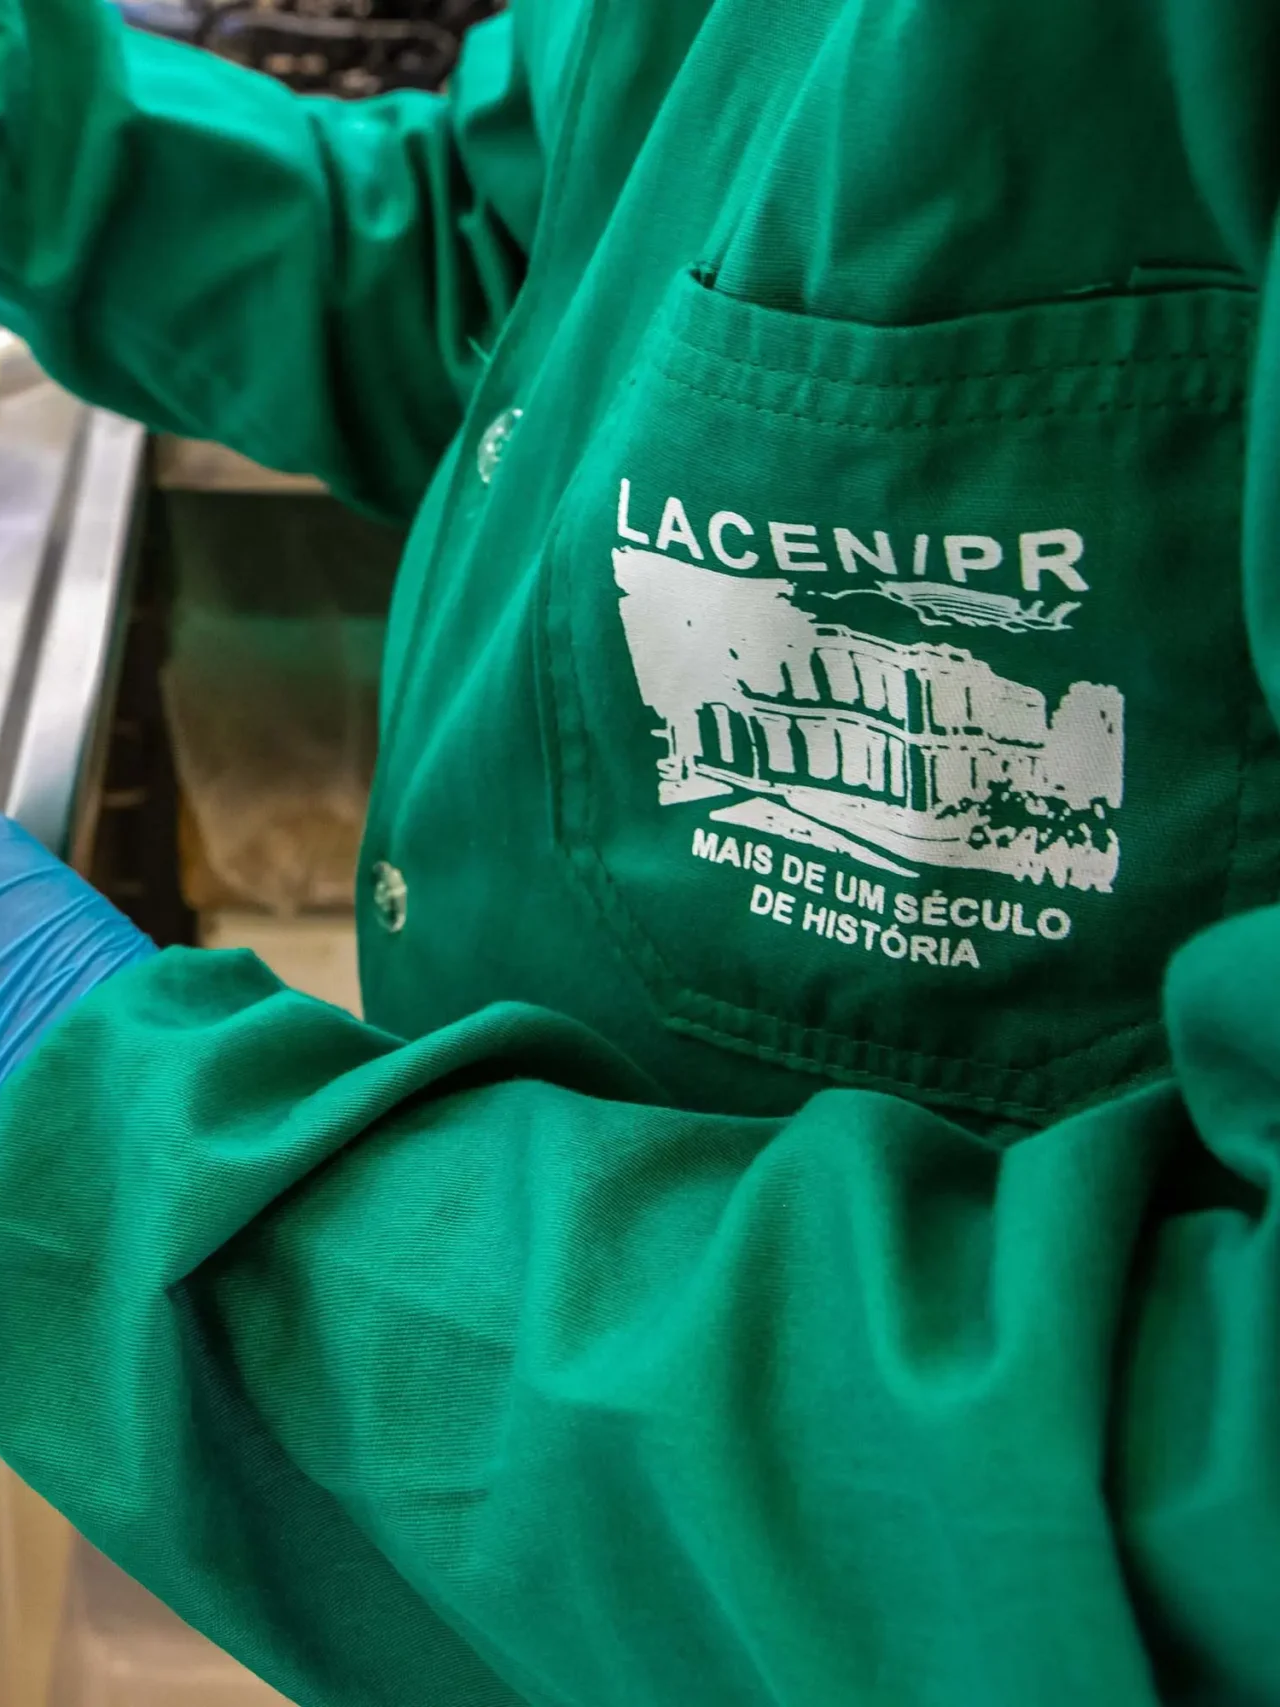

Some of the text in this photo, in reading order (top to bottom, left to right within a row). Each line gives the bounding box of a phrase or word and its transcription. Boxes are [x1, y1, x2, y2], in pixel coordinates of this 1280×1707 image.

[617, 477, 1089, 591] LACEN/PR
[692, 828, 1071, 939] MAIS DE UM SÉCULO
[751, 885, 980, 968] DE HISTÓRIA
